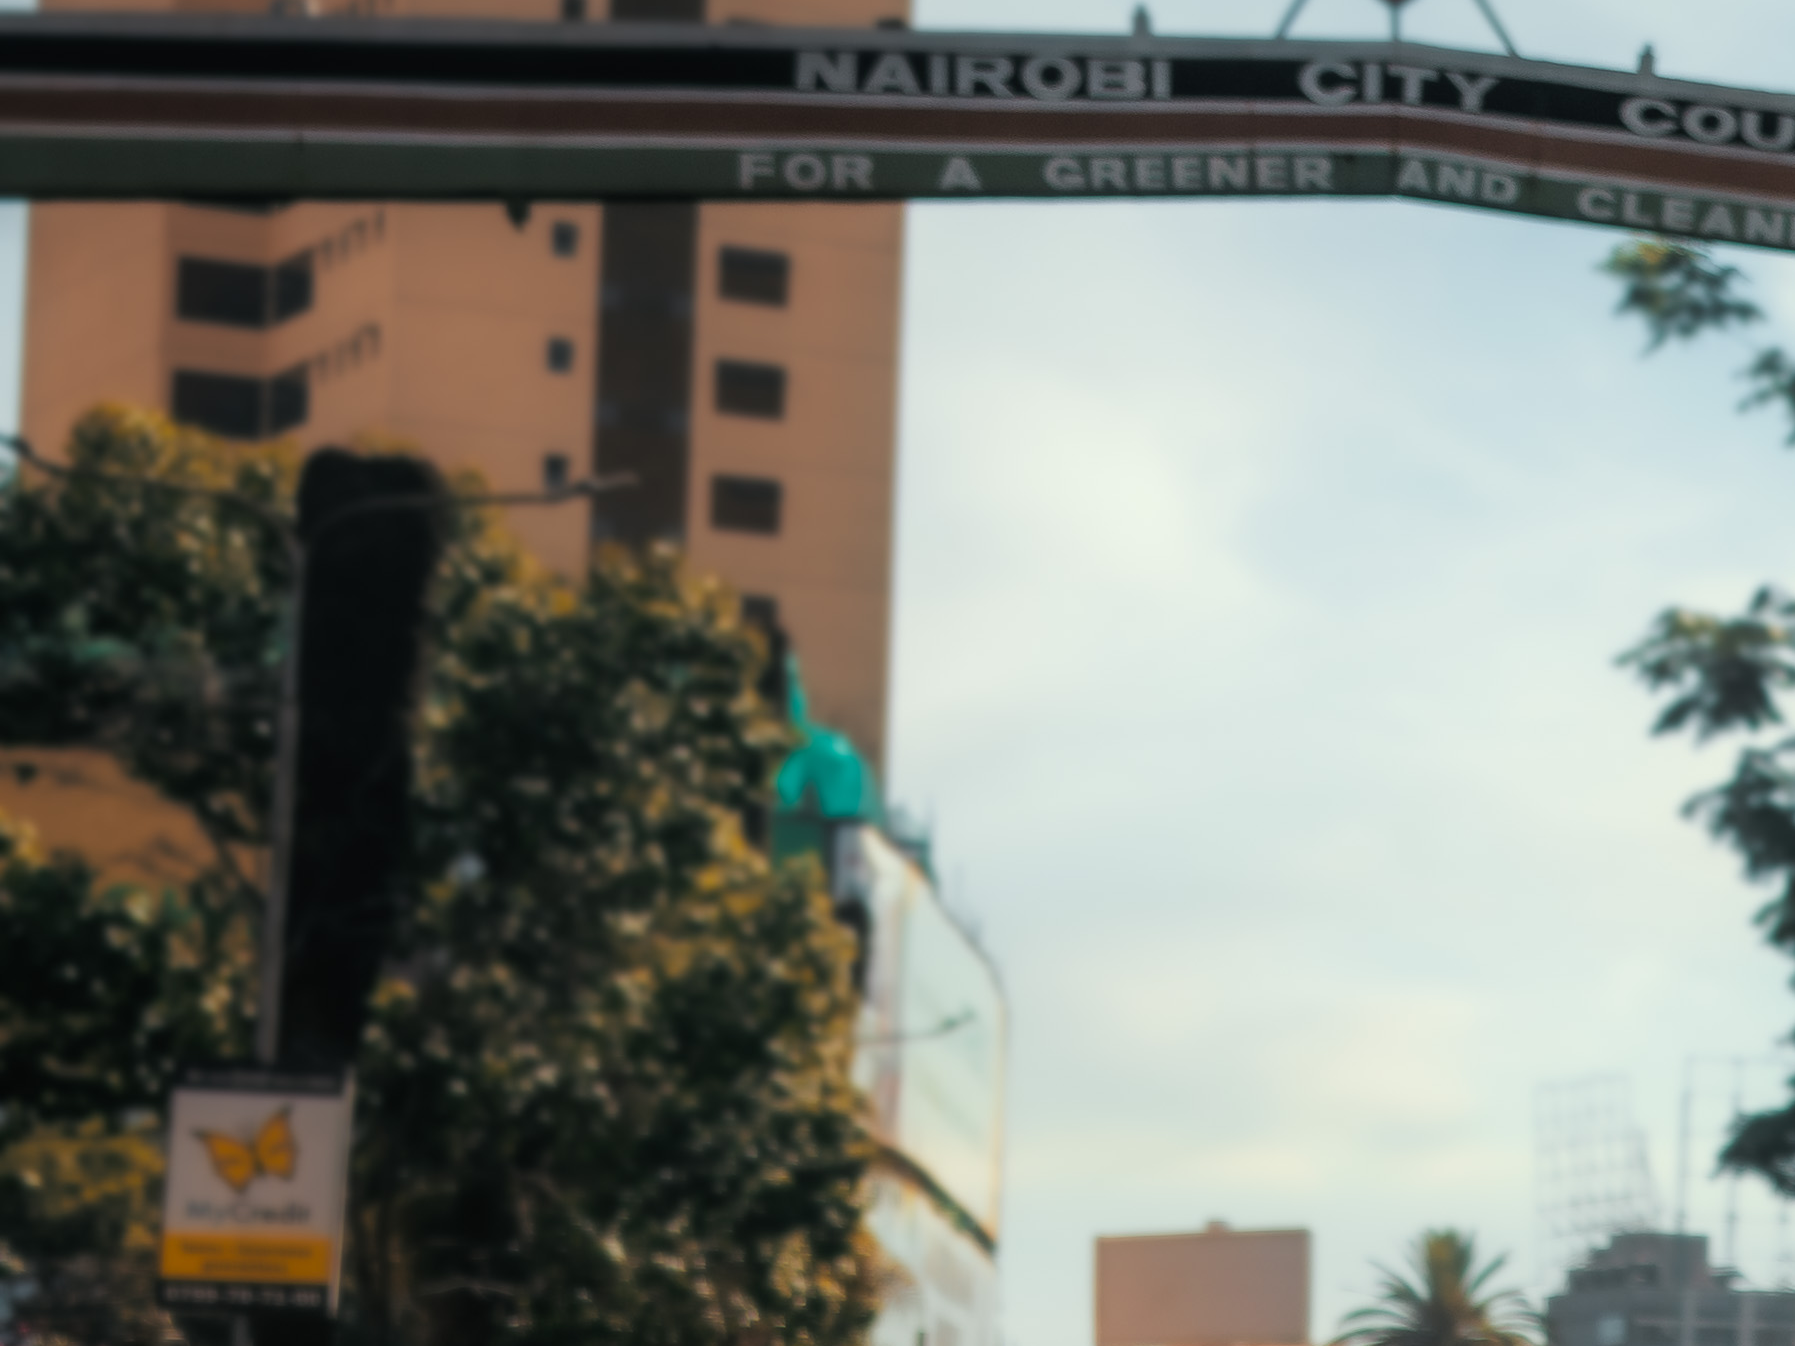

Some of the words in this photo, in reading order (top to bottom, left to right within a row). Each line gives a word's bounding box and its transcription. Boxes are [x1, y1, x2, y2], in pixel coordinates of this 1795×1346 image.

[793, 53, 1171, 101] NAIROBI
[1300, 60, 1499, 114] CITY
[738, 154, 874, 191] FOR
[940, 157, 982, 191] A
[1043, 155, 1334, 191] GREENER
[1396, 158, 1518, 207] AND
